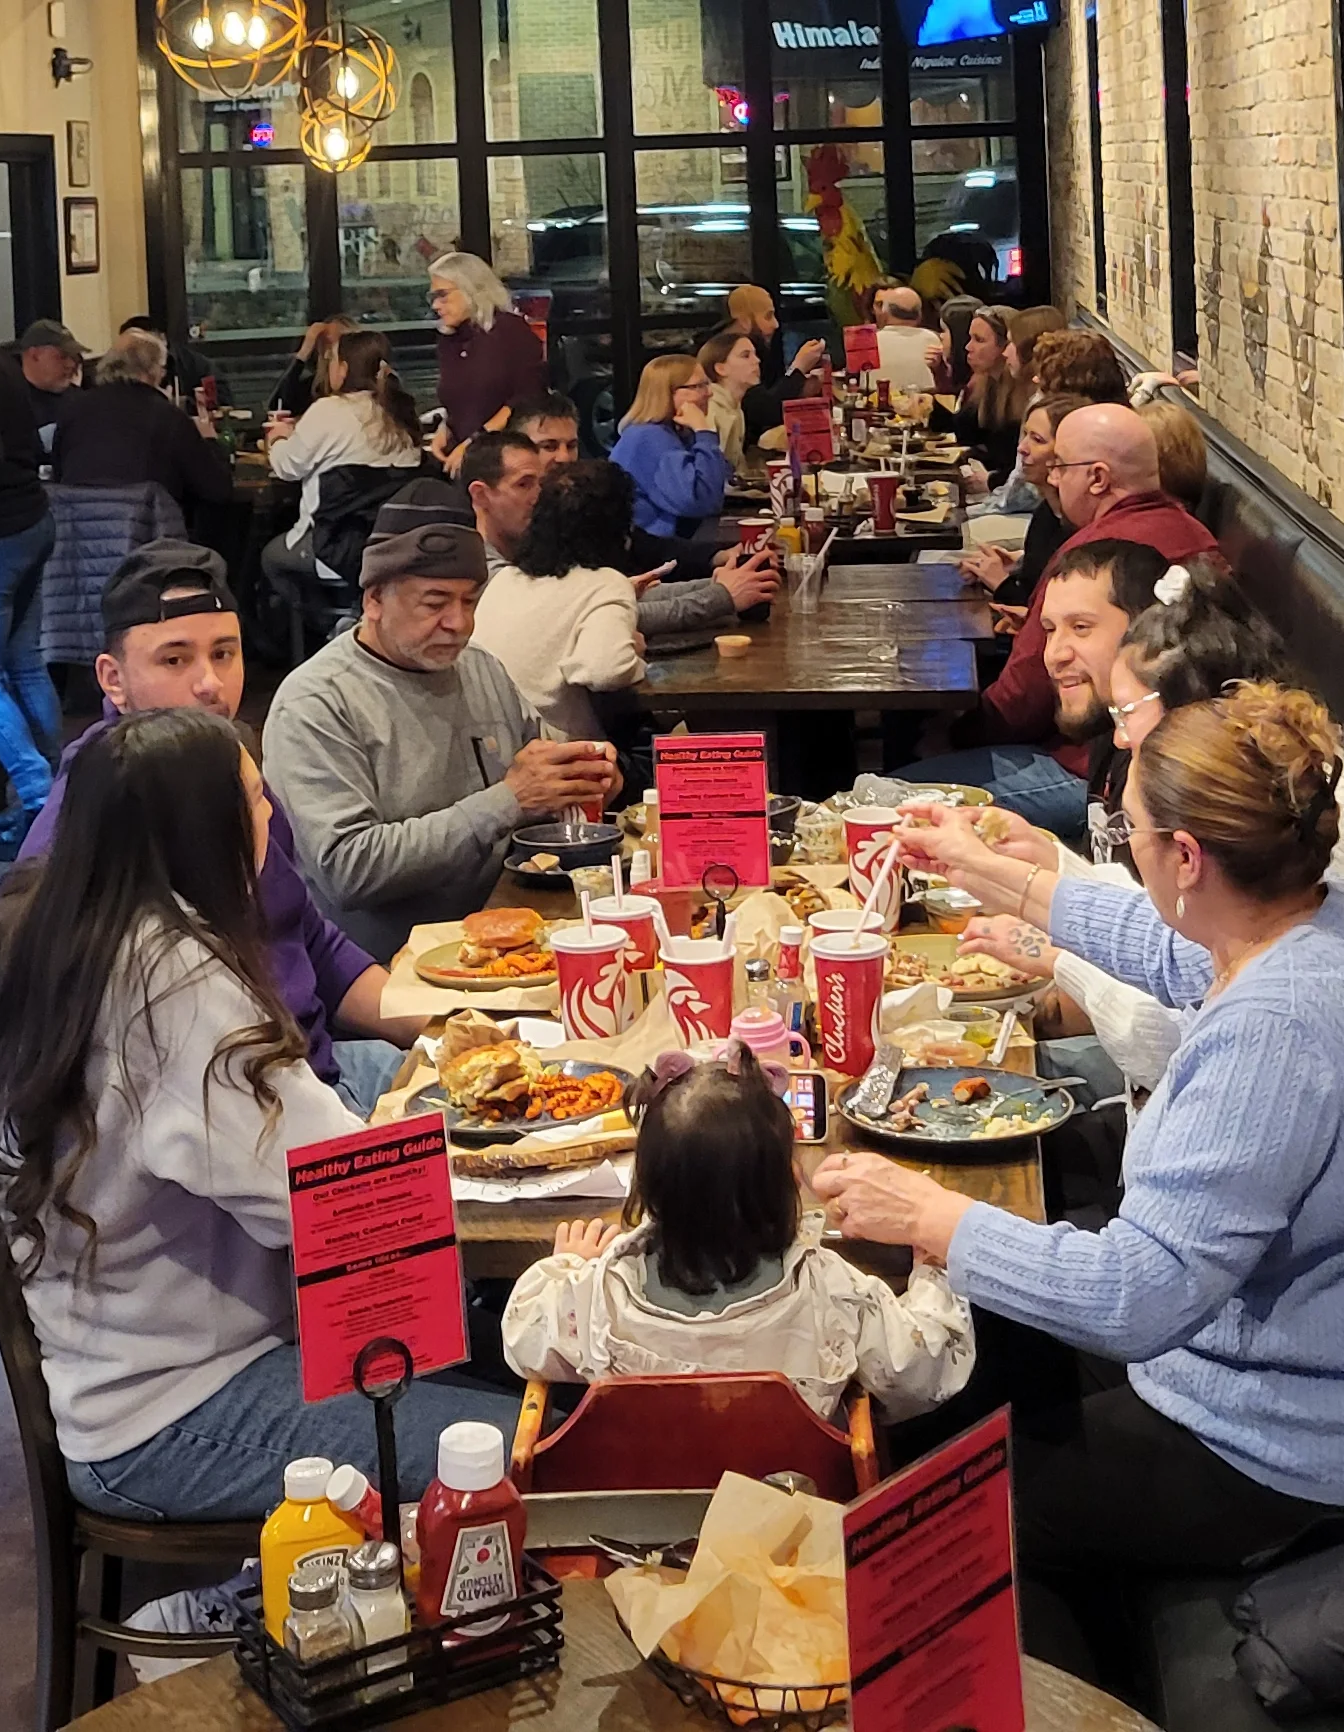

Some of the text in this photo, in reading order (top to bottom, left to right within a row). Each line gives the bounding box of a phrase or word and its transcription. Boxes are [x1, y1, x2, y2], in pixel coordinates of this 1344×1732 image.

[959, 54, 1003, 67] Cuisines
[660, 750, 762, 760] Healthy Eating Guide
[825, 973, 846, 1064] Clucker's
[294, 1160, 351, 1186] Healthy
[353, 1147, 400, 1170] Eating
[402, 1136, 444, 1156] Guide
[456, 1581, 506, 1602] TOMATO
